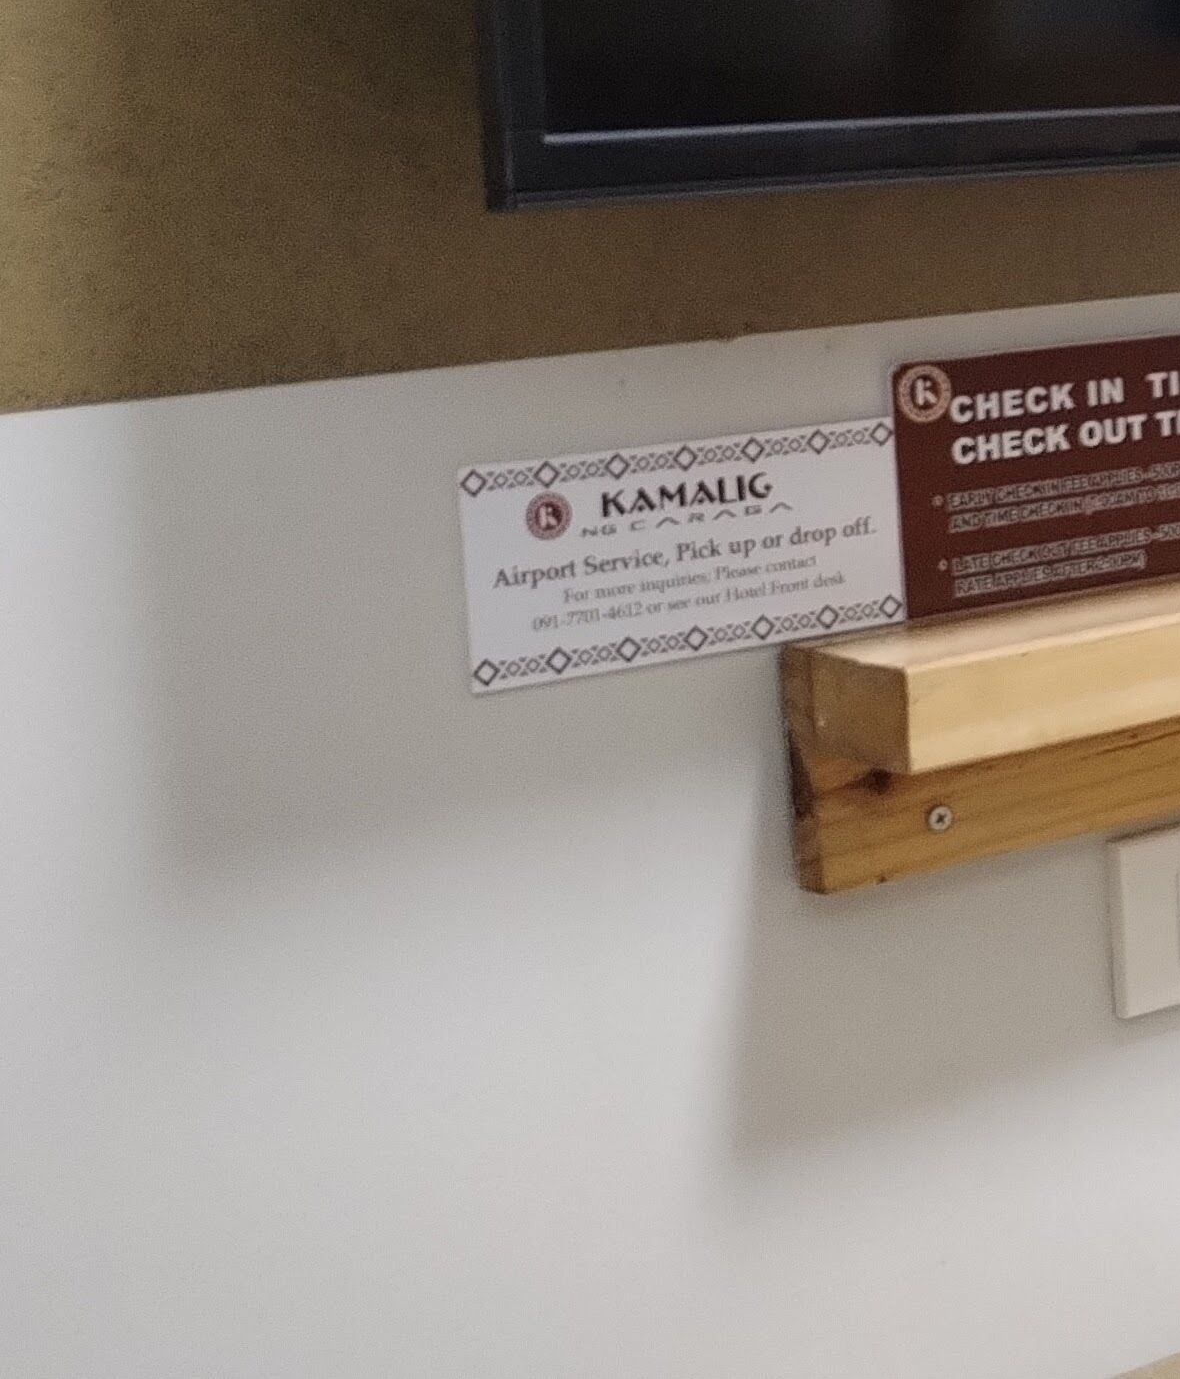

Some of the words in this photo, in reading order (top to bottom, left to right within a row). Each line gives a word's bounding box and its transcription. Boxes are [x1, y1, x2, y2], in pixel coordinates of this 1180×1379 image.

[950, 383, 1075, 424] CHECK
[1086, 377, 1125, 407] IN
[951, 424, 1071, 465] CHECK
[1078, 414, 1148, 447] OUT
[601, 471, 773, 518] KAMALIG
[492, 559, 577, 590] Airport
[583, 549, 670, 576] Service,
[676, 537, 722, 562] Pick
[728, 538, 756, 558] up
[761, 533, 784, 550] or
[789, 526, 837, 547] drop
[842, 516, 877, 538] off.
[563, 587, 589, 603] For
[594, 583, 636, 600] more
[716, 565, 761, 581] Please
[765, 556, 817, 573] contact
[647, 602, 663, 615] or
[695, 592, 721, 606] our
[726, 583, 767, 602] Hotel
[770, 577, 809, 595] Front
[813, 571, 846, 589] desk
